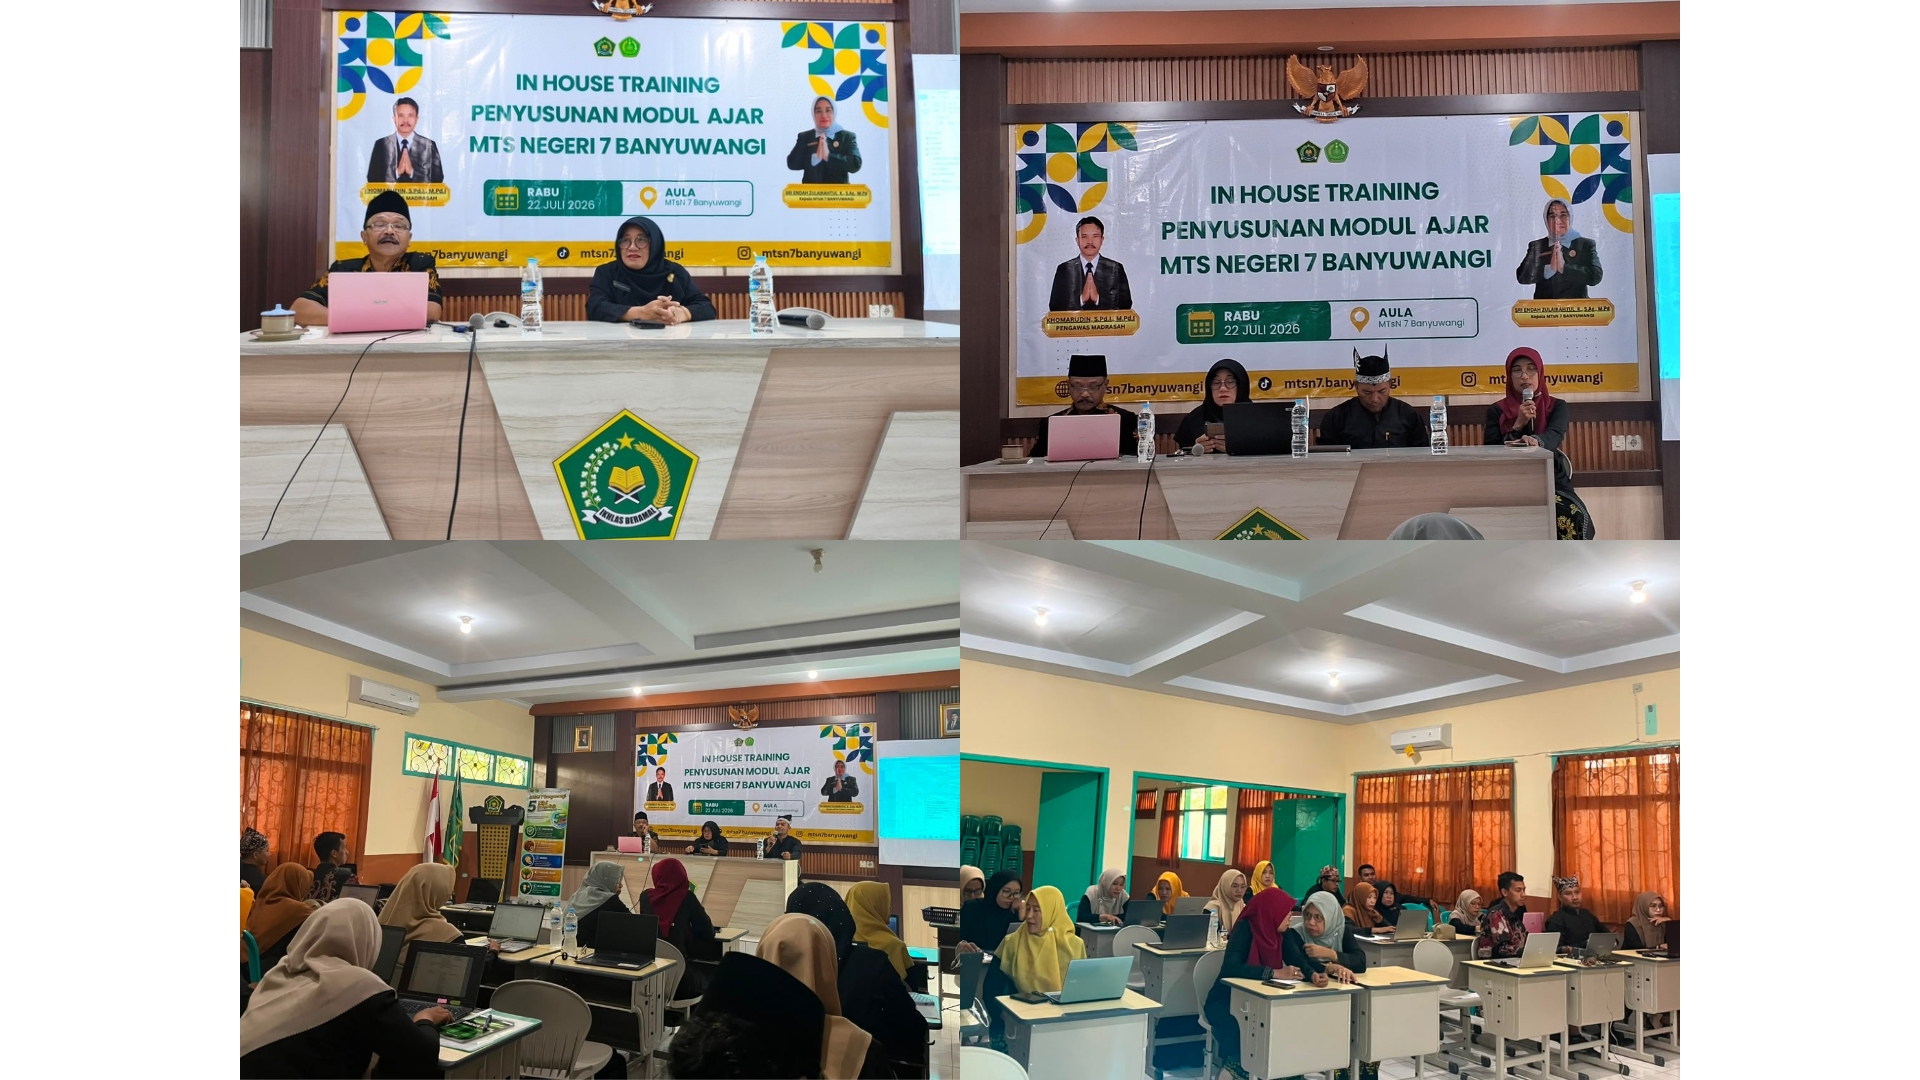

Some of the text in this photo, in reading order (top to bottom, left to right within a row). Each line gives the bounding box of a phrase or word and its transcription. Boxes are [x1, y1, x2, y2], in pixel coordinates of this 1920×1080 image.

[516, 74, 720, 94] IN HOUSE TRAINING
[471, 104, 764, 124] PENYUSUNAN MODUL AJAR
[469, 136, 766, 156] MTS NEGERI 7 BANYUWANGI
[528, 188, 560, 198] RABU
[665, 188, 696, 198] AULA
[1210, 182, 1439, 204] IN HOUSE TRAINING
[527, 200, 595, 210] 22 JULI 2026
[665, 198, 742, 208] MTsN 7 Banyuwangi
[1162, 215, 1490, 240] PENYUSUNAN MODUL AJAR
[762, 248, 861, 260] mtsn7banyuwangi
[1160, 249, 1492, 274] MTS NEGERI 7 BANYUWANGI
[1224, 310, 1260, 322] RABU
[1378, 307, 1413, 318] AULA
[1378, 318, 1465, 329] MTsN 7 Banyuwangi
[1224, 323, 1300, 336] 22 JULI 2026
[599, 508, 657, 524] IKHLAS BERAMAL
[713, 754, 742, 762] HOUSE
[744, 753, 790, 761] TRAINING
[684, 766, 810, 776] PENYUSUNAN MODUL AJAR
[736, 781, 740, 789] 7
[742, 781, 810, 789] BANYUWANGI
[528, 801, 536, 811] 5
